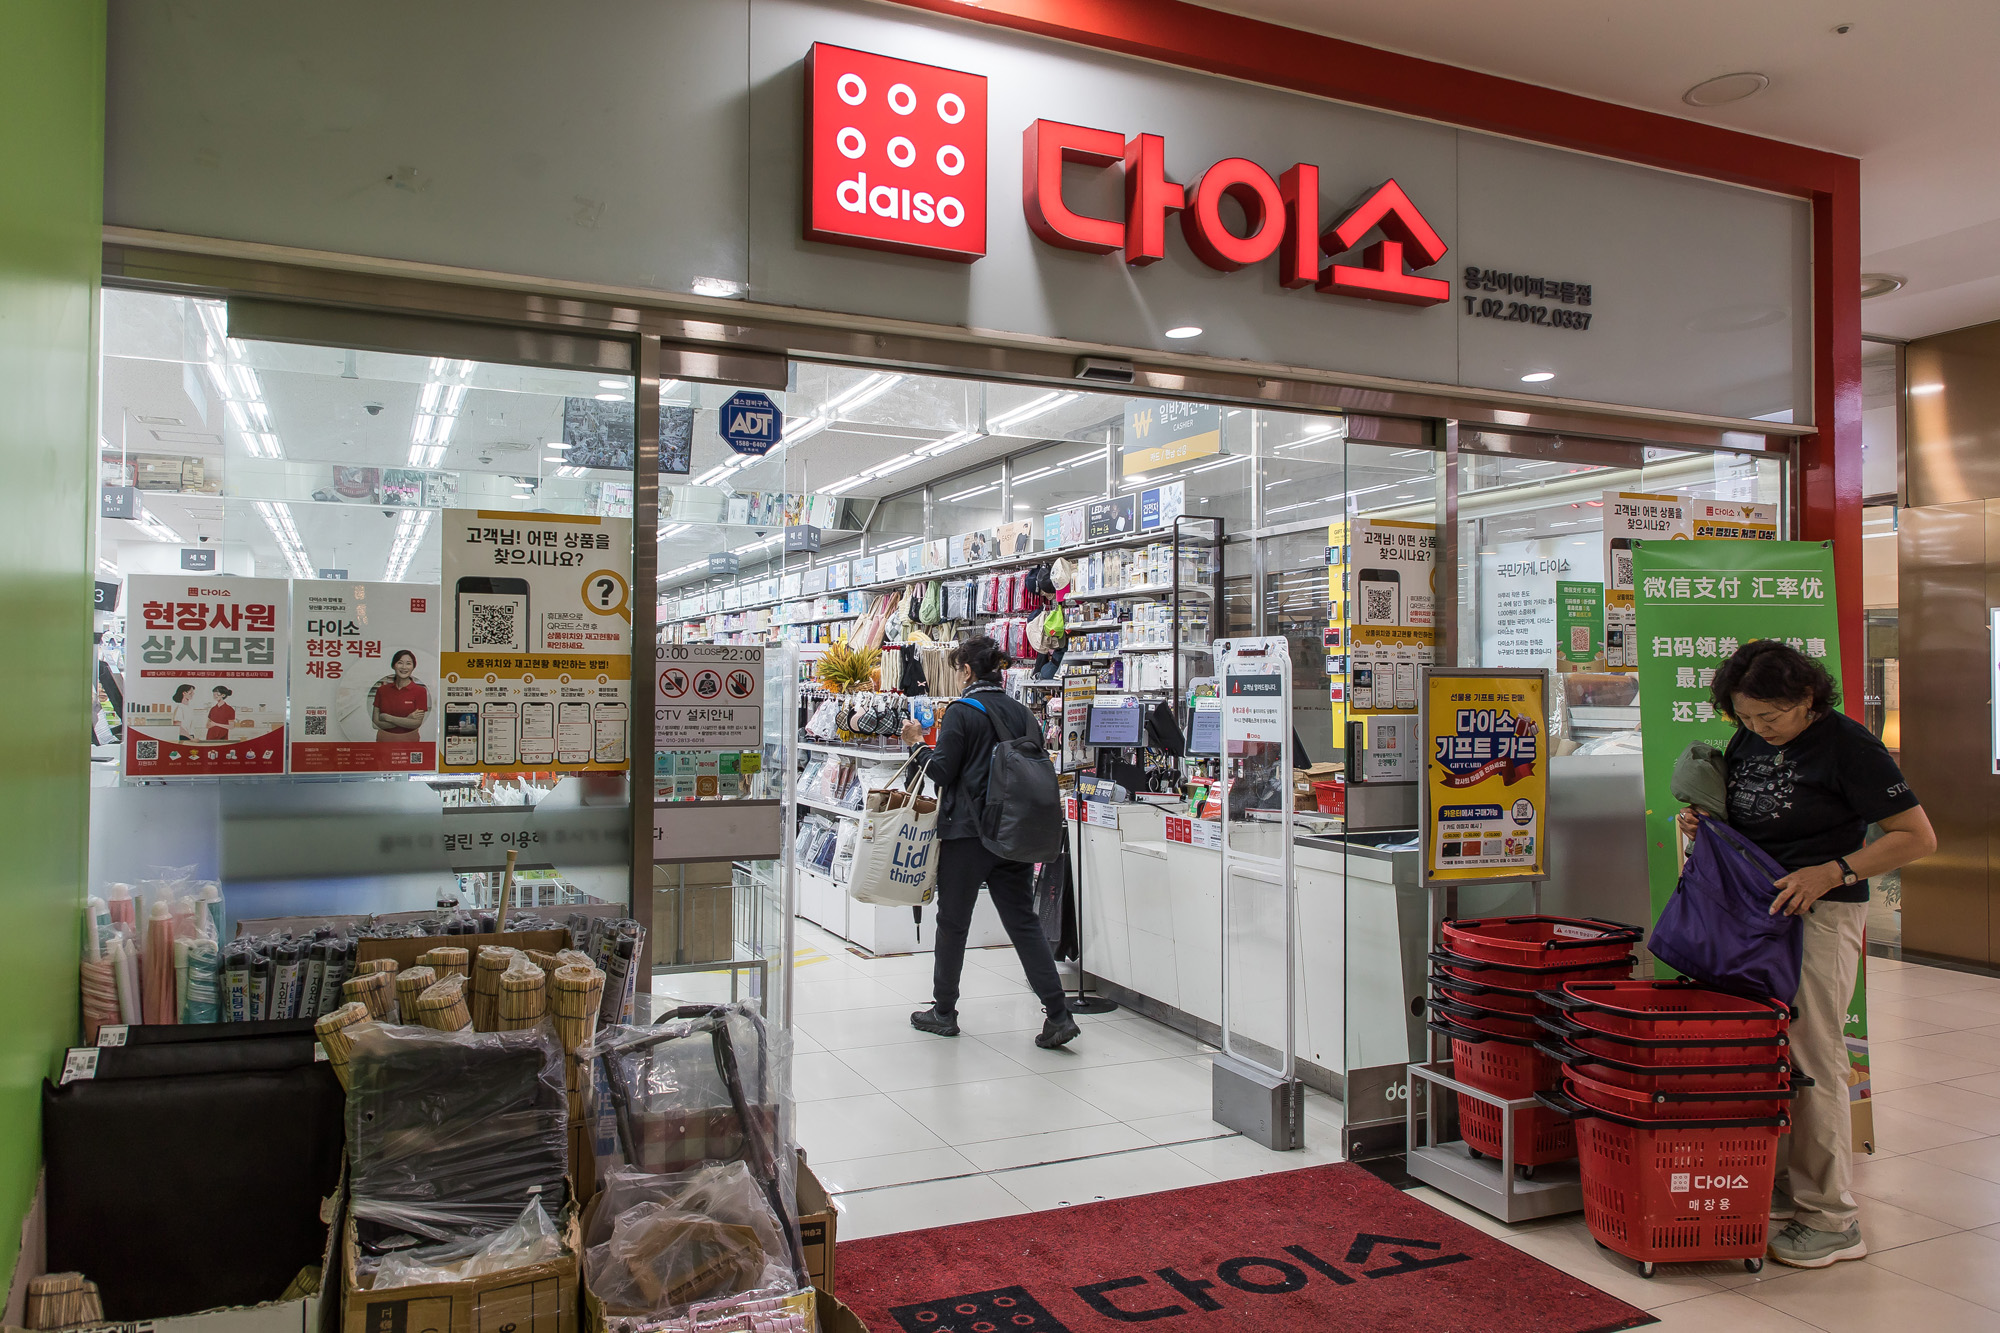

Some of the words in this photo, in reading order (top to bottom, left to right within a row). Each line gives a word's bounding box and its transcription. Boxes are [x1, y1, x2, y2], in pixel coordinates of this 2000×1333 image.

[836, 171, 966, 228] daiso
[1023, 117, 1451, 308] 다이소
[729, 411, 773, 436] ADT
[1173, 419, 1194, 431] CASHIER
[735, 440, 767, 448] 1588-6400
[1614, 503, 1640, 516] 고객님!
[1642, 505, 1658, 518] 어떤
[1659, 507, 1683, 520] 상품을
[1714, 508, 1735, 517] 다이소
[1627, 518, 1671, 531] 찾으시나요?
[466, 527, 521, 546] 고객님!
[527, 530, 558, 547] 어떤
[563, 532, 610, 550] 상품을
[1363, 532, 1395, 546] 고객님!
[1397, 534, 1416, 547] 어떤
[1714, 527, 1739, 539] 범죄도
[1740, 528, 1756, 540] 처벌
[1758, 529, 1776, 541] 대상!
[494, 548, 584, 567] 찾으시나요?
[1379, 547, 1431, 562] 찾으시나요?
[1497, 561, 1538, 578] 국민가게,
[1539, 558, 1572, 574] 다이소
[201, 589, 232, 597] 다이소
[1643, 576, 1741, 600] 微信支付
[1751, 577, 1824, 600] 汇率优
[142, 600, 275, 632] 현장사원
[307, 619, 361, 637] 다이소
[546, 622, 574, 631] QR코드
[575, 623, 590, 631] 스캔
[547, 632, 584, 641] 상품위치와
[140, 635, 275, 666] 상시모집
[305, 638, 344, 658] 현장
[345, 640, 382, 659] 직원
[694, 647, 721, 656] CLOSE
[721, 648, 761, 661] 22:00
[305, 660, 344, 679] 채용
[466, 658, 512, 669] 상품위치와
[514, 659, 550, 669] 재고현황
[552, 659, 587, 669] 확인하는
[589, 659, 609, 670] 방법!
[525, 676, 531, 684] 3
[562, 676, 568, 684] 4
[1473, 693, 1495, 702] 기프트
[1496, 694, 1510, 702] 카드
[686, 709, 734, 722] 설치안내
[1457, 710, 1515, 733] 다이소
[1436, 736, 1492, 760] 기프트
[1498, 736, 1536, 759] 카드
[1443, 808, 1474, 818] 카운터에서
[478, 831, 495, 848] 후
[898, 823, 918, 841] All
[919, 827, 938, 843] my
[892, 842, 930, 869] Lidl
[889, 867, 927, 887] things
[1693, 1173, 1750, 1190] 다이소
[1071, 1232, 1475, 1323] 다이소
